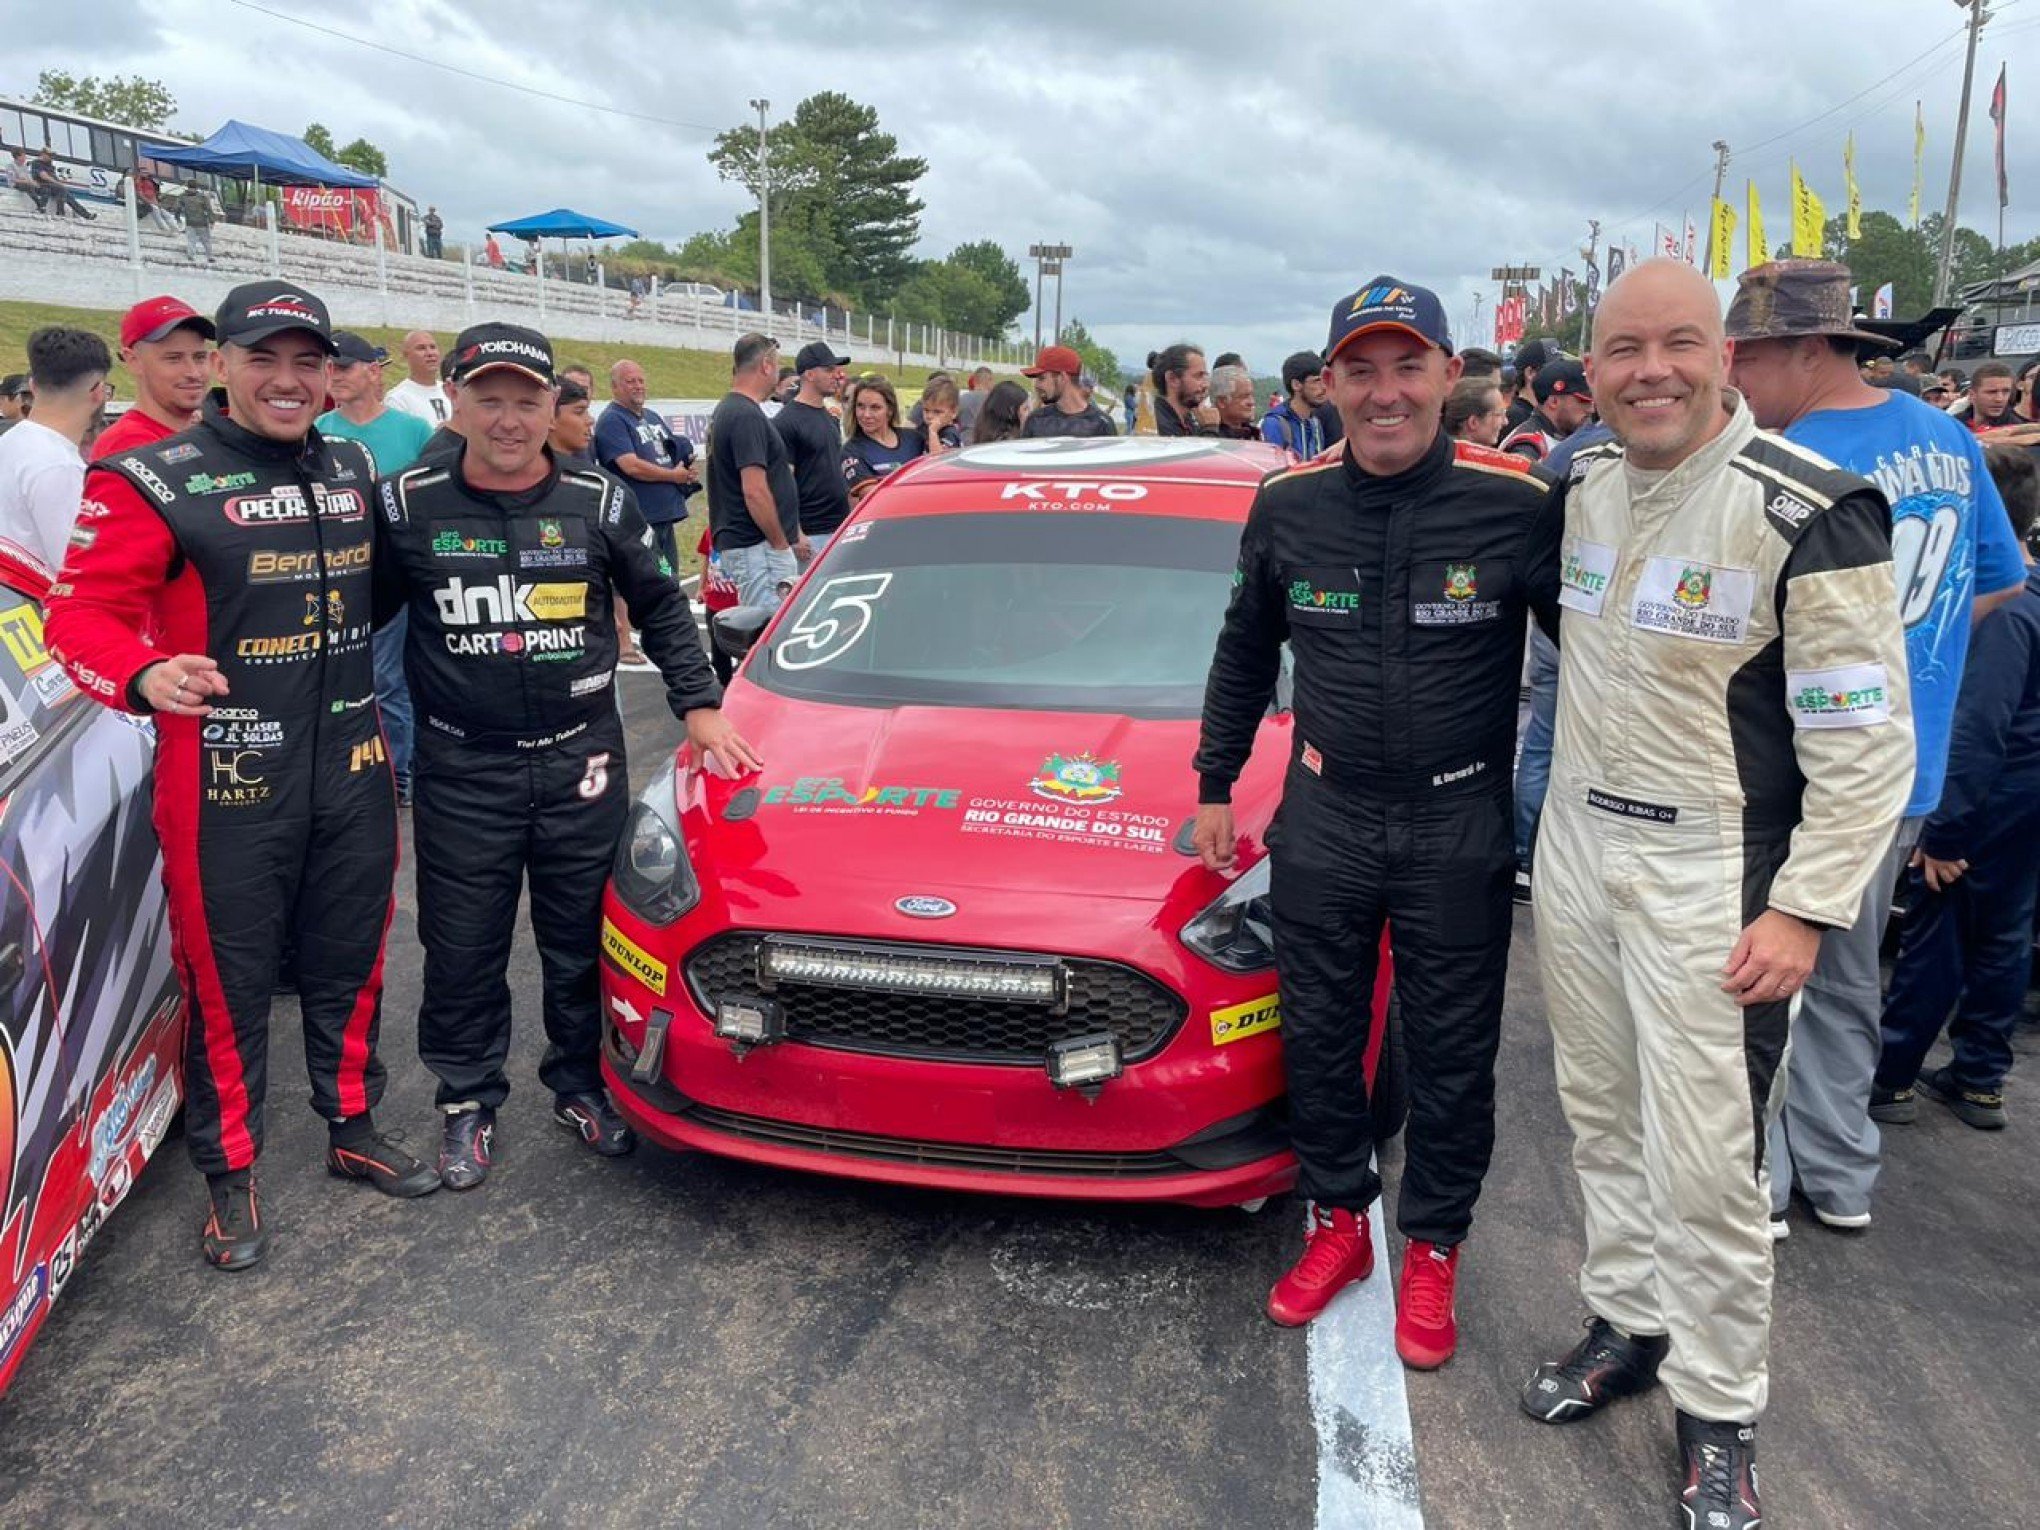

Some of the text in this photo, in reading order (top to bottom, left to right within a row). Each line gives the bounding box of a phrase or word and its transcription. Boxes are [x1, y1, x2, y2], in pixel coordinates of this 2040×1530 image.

[479, 340, 551, 365] YOKOHAMA
[120, 457, 177, 505] sparco
[1000, 481, 1148, 500] KTO
[1027, 502, 1111, 510] KTO.COM
[1773, 495, 1810, 521] OMP
[433, 573, 537, 626] dnk
[776, 572, 893, 672] 5
[578, 752, 610, 798] 5
[207, 787, 270, 800] HARTZ
[964, 809, 1167, 842] RIO GRANDE DO SUL
[969, 797, 1170, 828] GOVERNO DO ESTADO
[608, 936, 664, 983] DUNLOP
